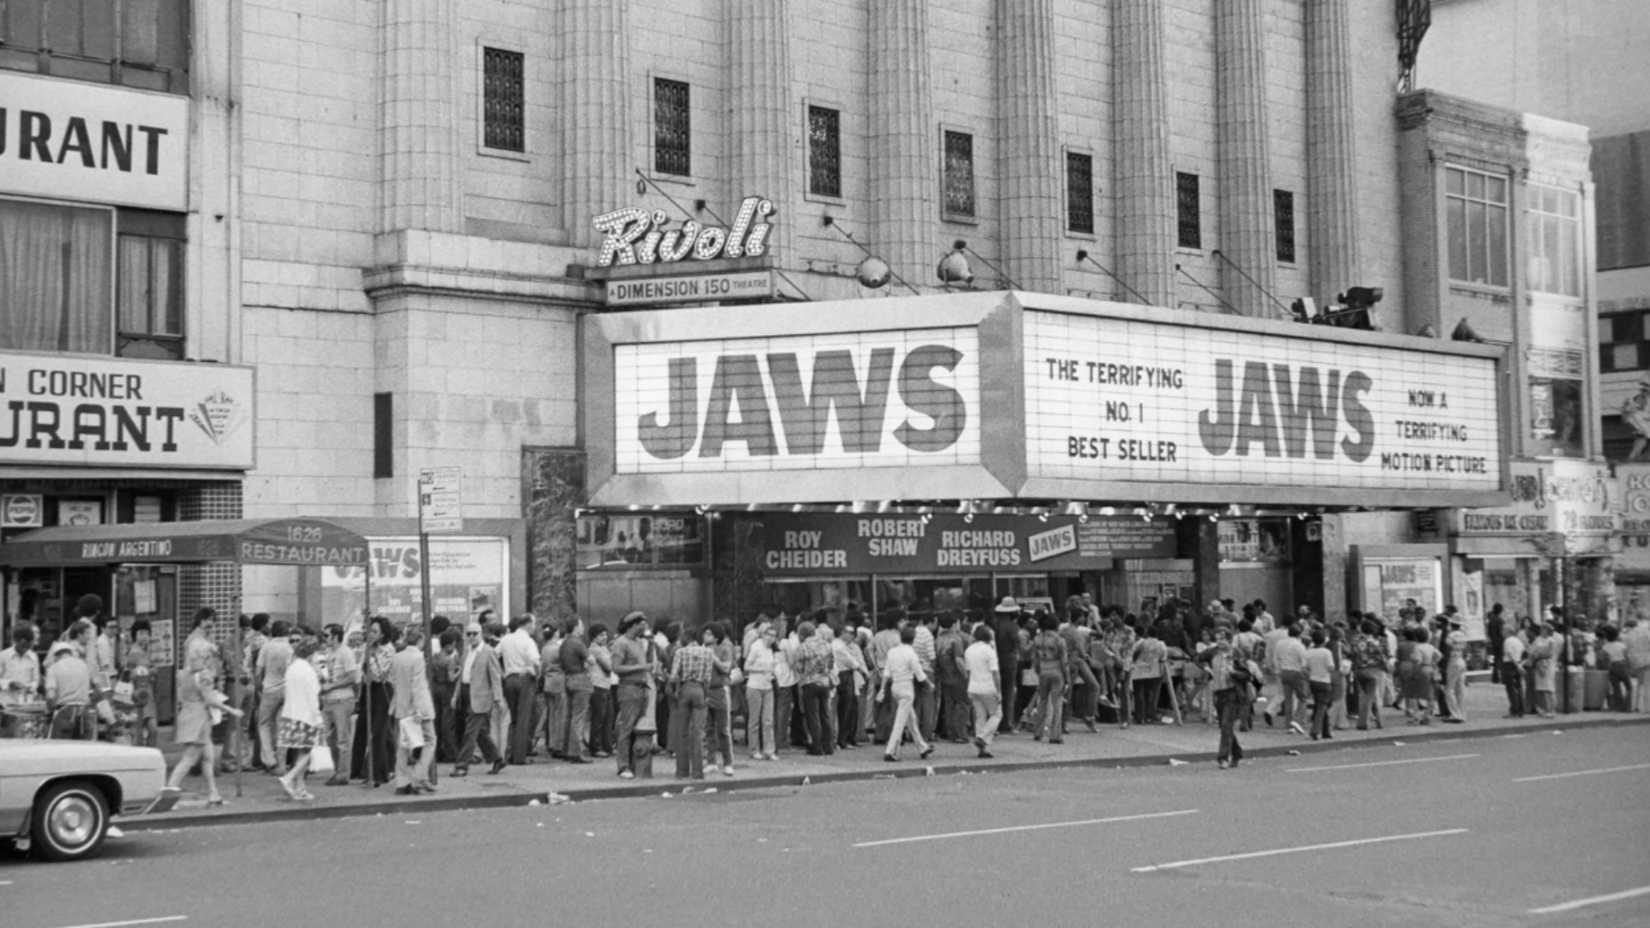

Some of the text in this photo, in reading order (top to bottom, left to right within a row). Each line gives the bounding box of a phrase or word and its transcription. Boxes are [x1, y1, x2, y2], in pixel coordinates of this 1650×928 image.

[0, 106, 168, 175] RANT
[592, 195, 774, 267] Rivoli
[617, 281, 699, 300] DIMENSION
[704, 278, 730, 294] 150
[732, 278, 768, 289] THEATRE
[28, 368, 143, 400] CORNER
[1045, 358, 1184, 390] THE TERRIFYING
[637, 344, 967, 460] JAWS
[1105, 400, 1132, 422] NO.
[1199, 358, 1375, 463] JAWS
[1408, 389, 1448, 410] NOW A
[1395, 420, 1468, 443] TERRIFYING
[1068, 436, 1177, 463] BEST SELLER
[1381, 452, 1488, 475] MOTION PICTURE
[784, 530, 823, 549] ROY
[857, 519, 926, 538] ROBERT
[941, 530, 1015, 548] RICHARD
[118, 538, 173, 557] ARGENTINO
[241, 543, 366, 562] RESTAURANT
[868, 538, 919, 556] SHAW
[1031, 529, 1074, 558] JAWS
[333, 547, 421, 579] WS
[936, 549, 1021, 568] DREYFUSS
